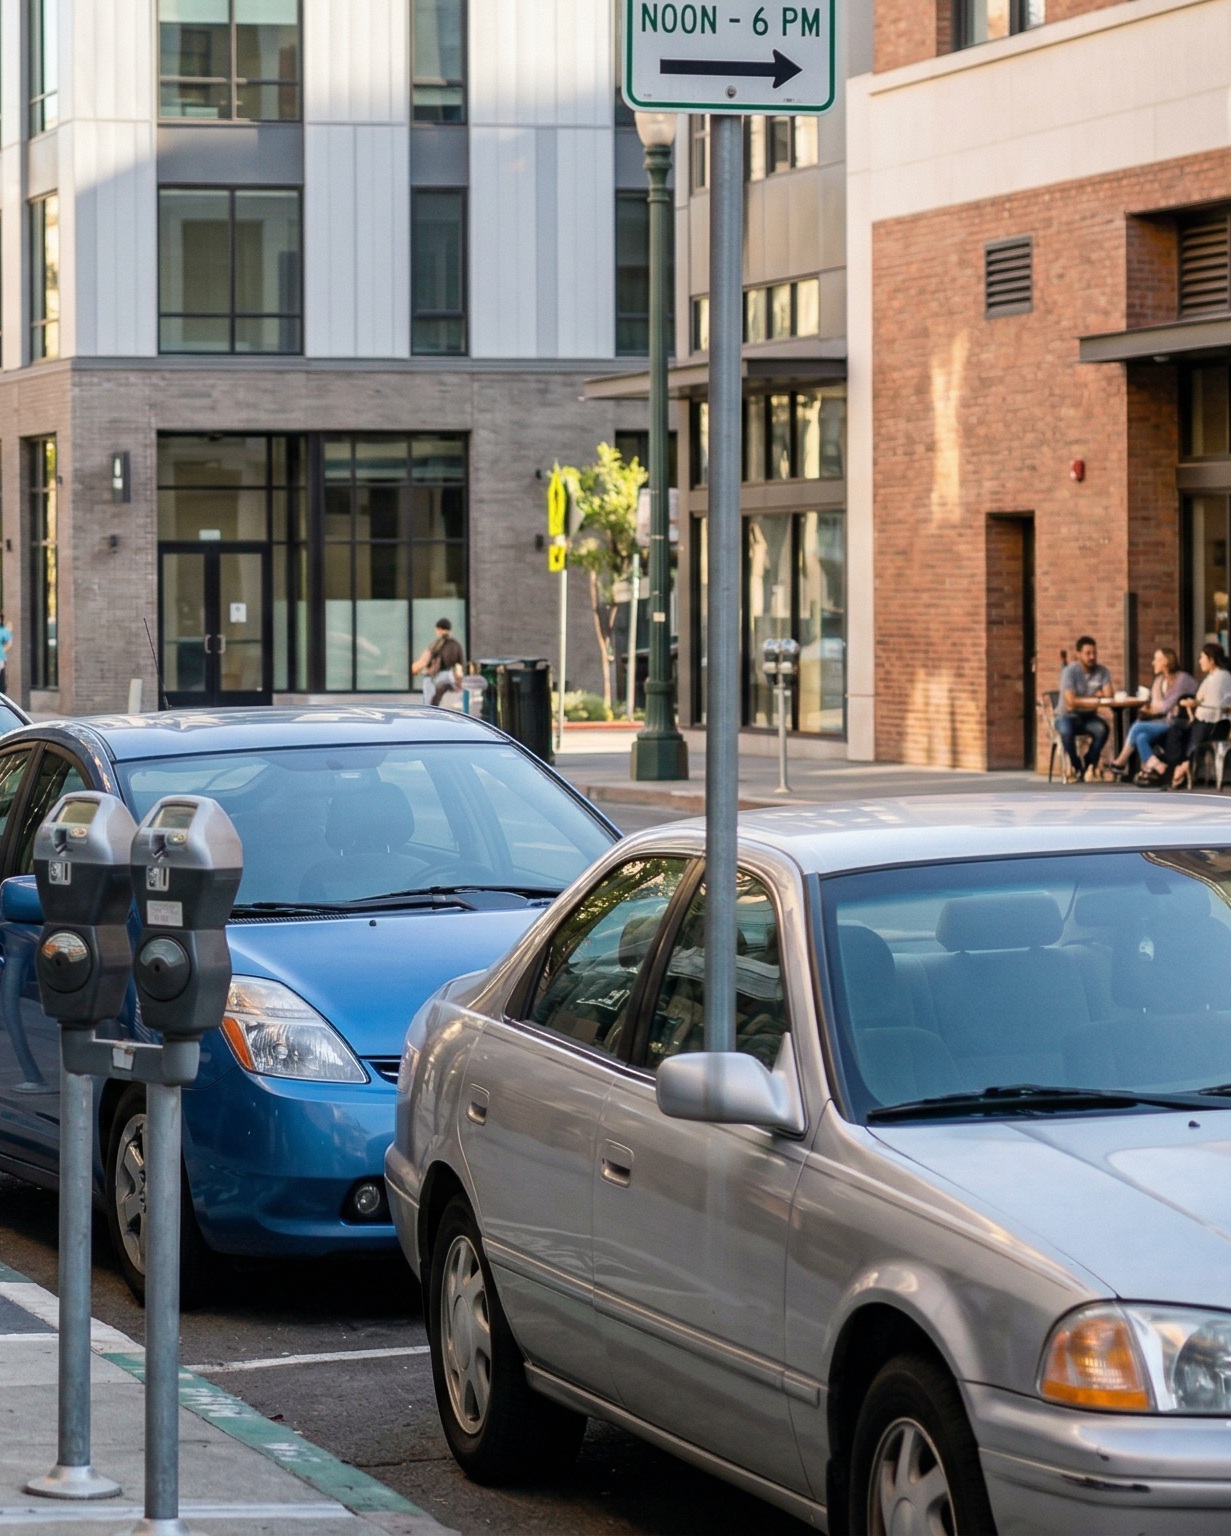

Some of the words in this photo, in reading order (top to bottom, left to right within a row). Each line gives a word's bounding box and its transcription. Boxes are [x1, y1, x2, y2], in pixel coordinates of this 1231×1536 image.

[641, 3, 717, 34] NOON
[752, 6, 769, 36] 6
[782, 7, 820, 37] PM
